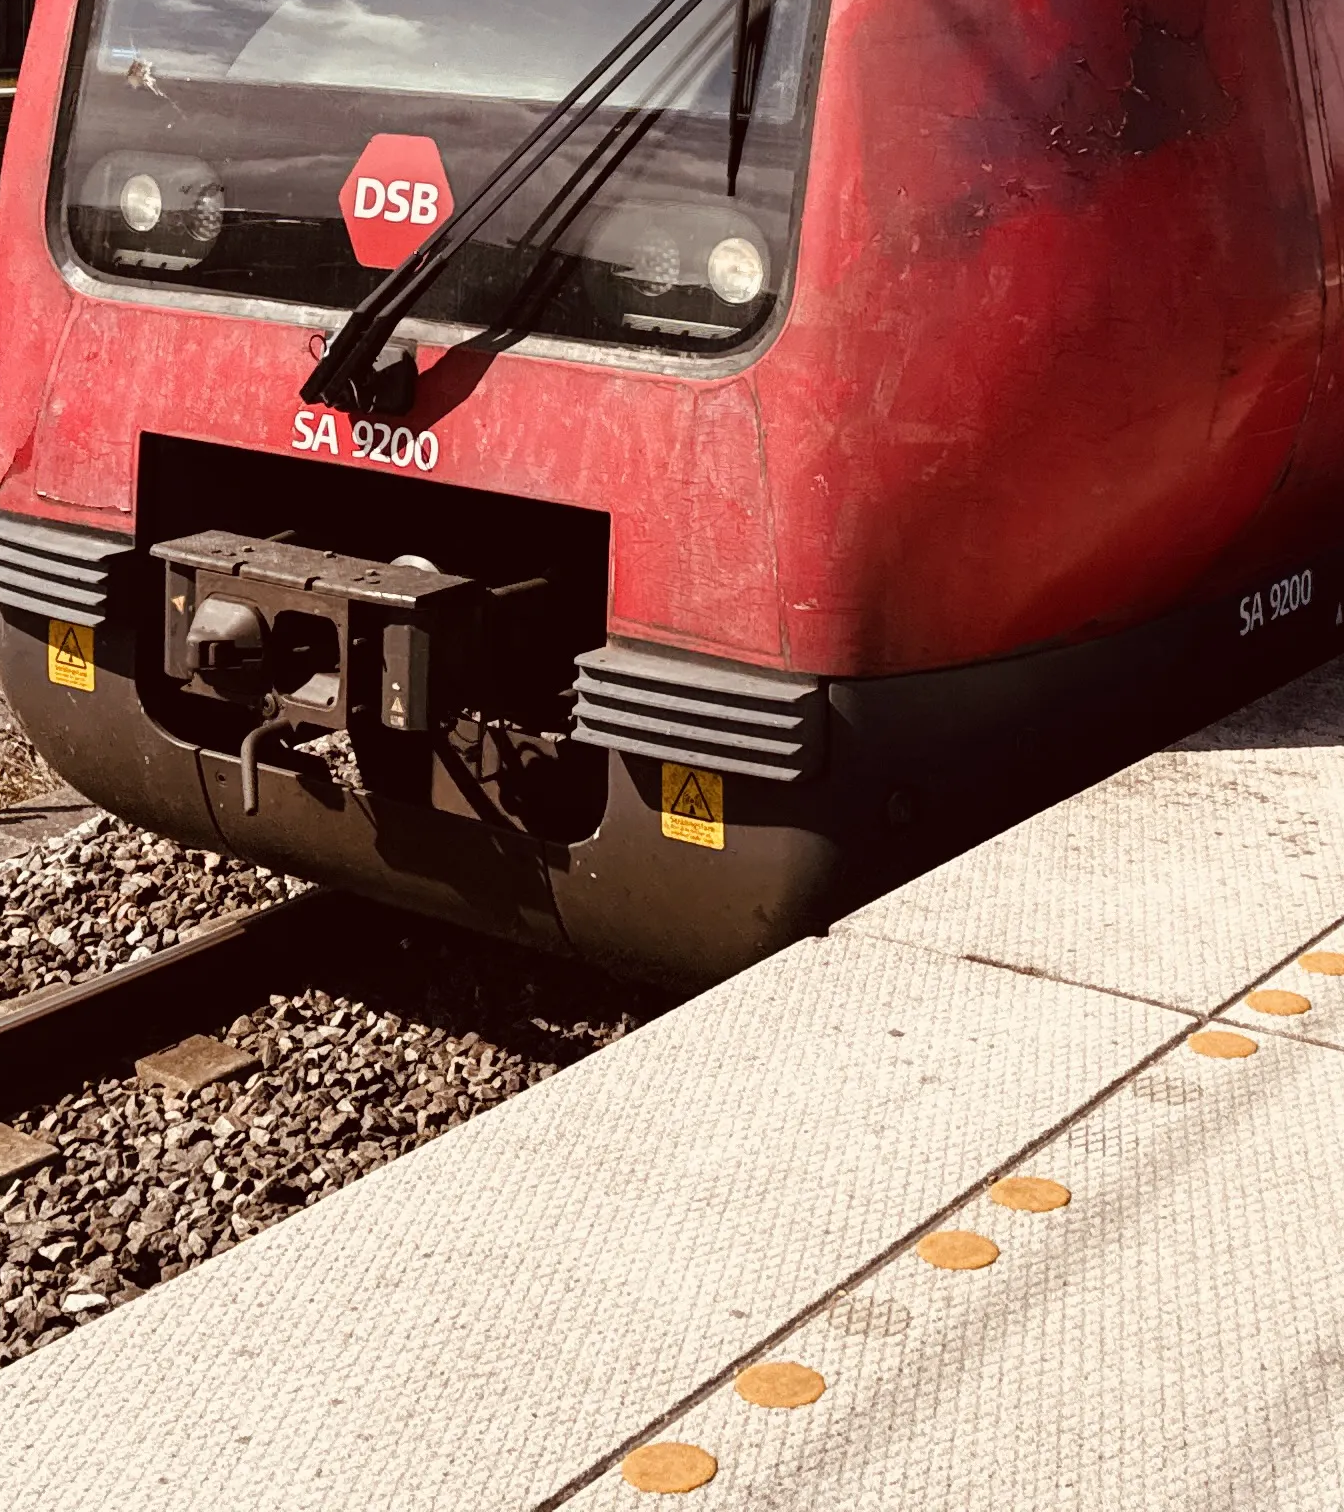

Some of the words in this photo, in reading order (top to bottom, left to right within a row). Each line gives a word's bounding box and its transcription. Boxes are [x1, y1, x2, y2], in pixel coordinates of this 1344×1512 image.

[353, 177, 439, 225] DSB
[291, 410, 339, 455] SA
[351, 420, 439, 472] 9200
[1240, 592, 1264, 636] SA
[1270, 569, 1312, 621] 9200
